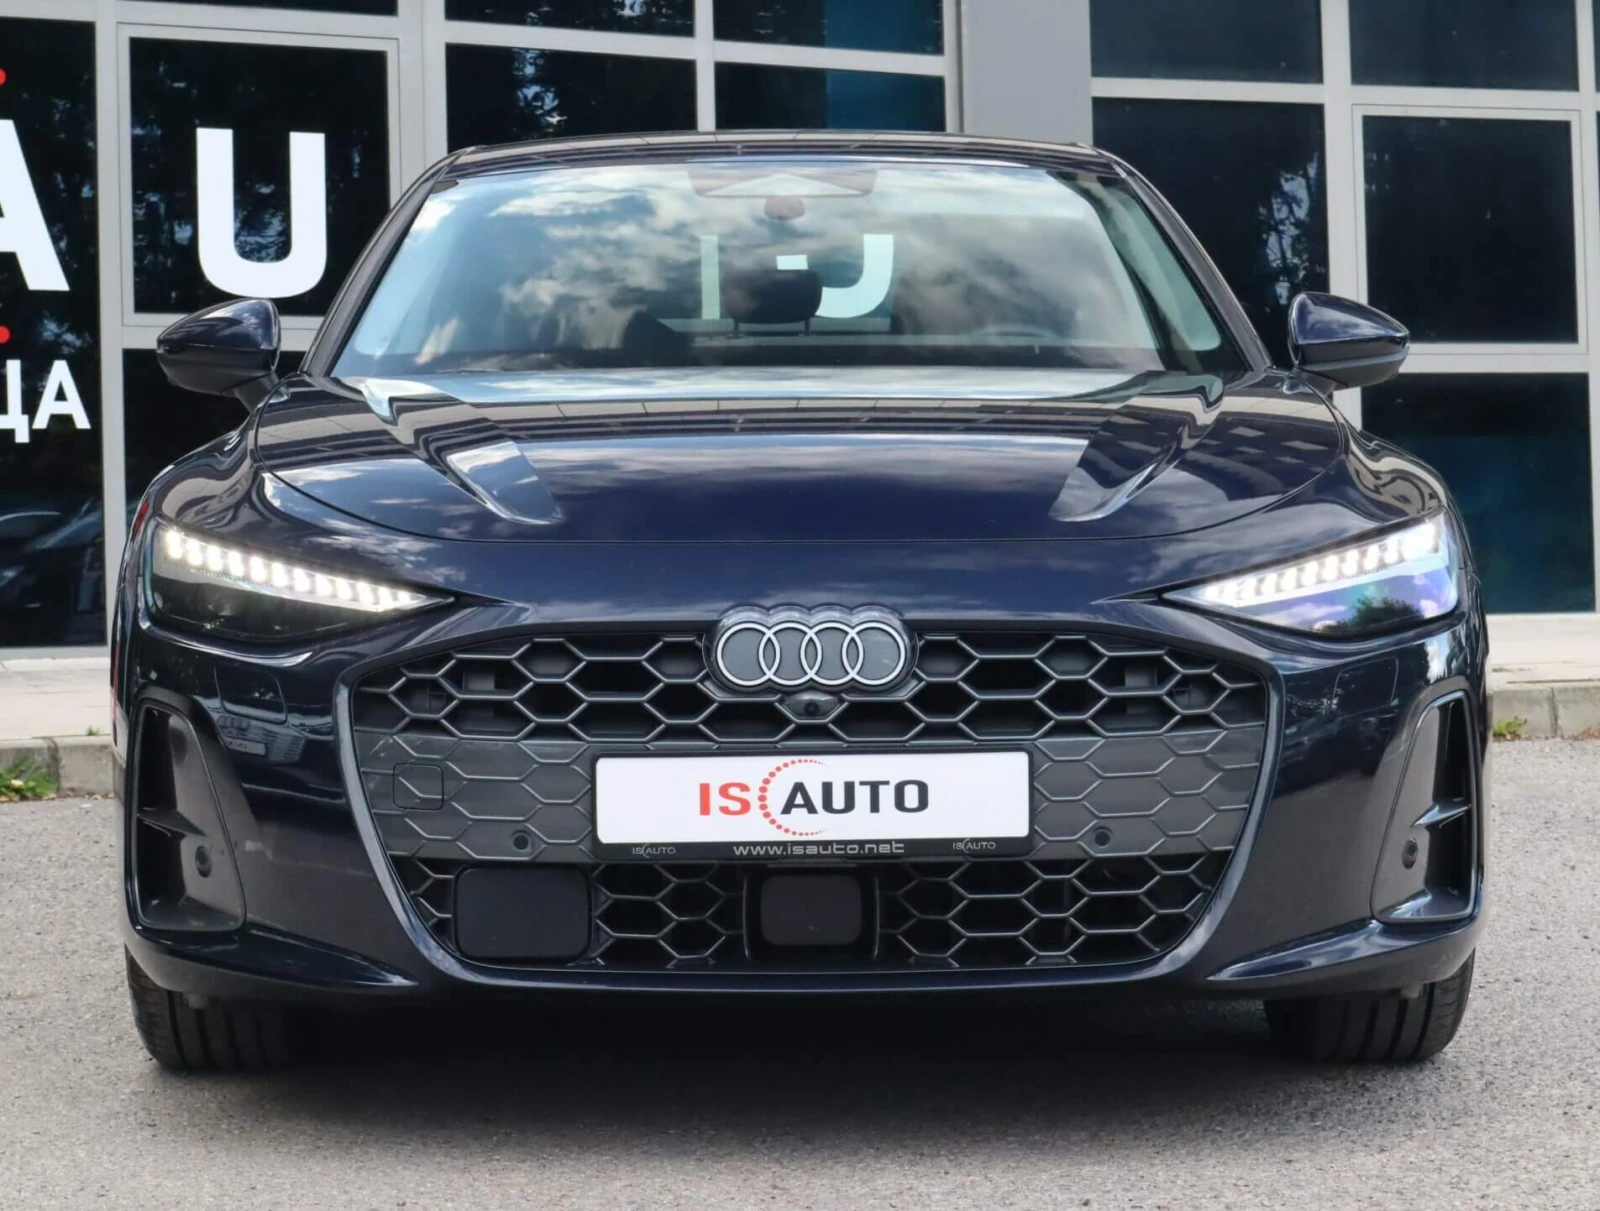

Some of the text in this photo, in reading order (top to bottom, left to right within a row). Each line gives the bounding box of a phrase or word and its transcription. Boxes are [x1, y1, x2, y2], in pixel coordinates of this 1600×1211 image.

[699, 779, 929, 816] IS AUTO
[733, 841, 905, 855] www.isauto.net
